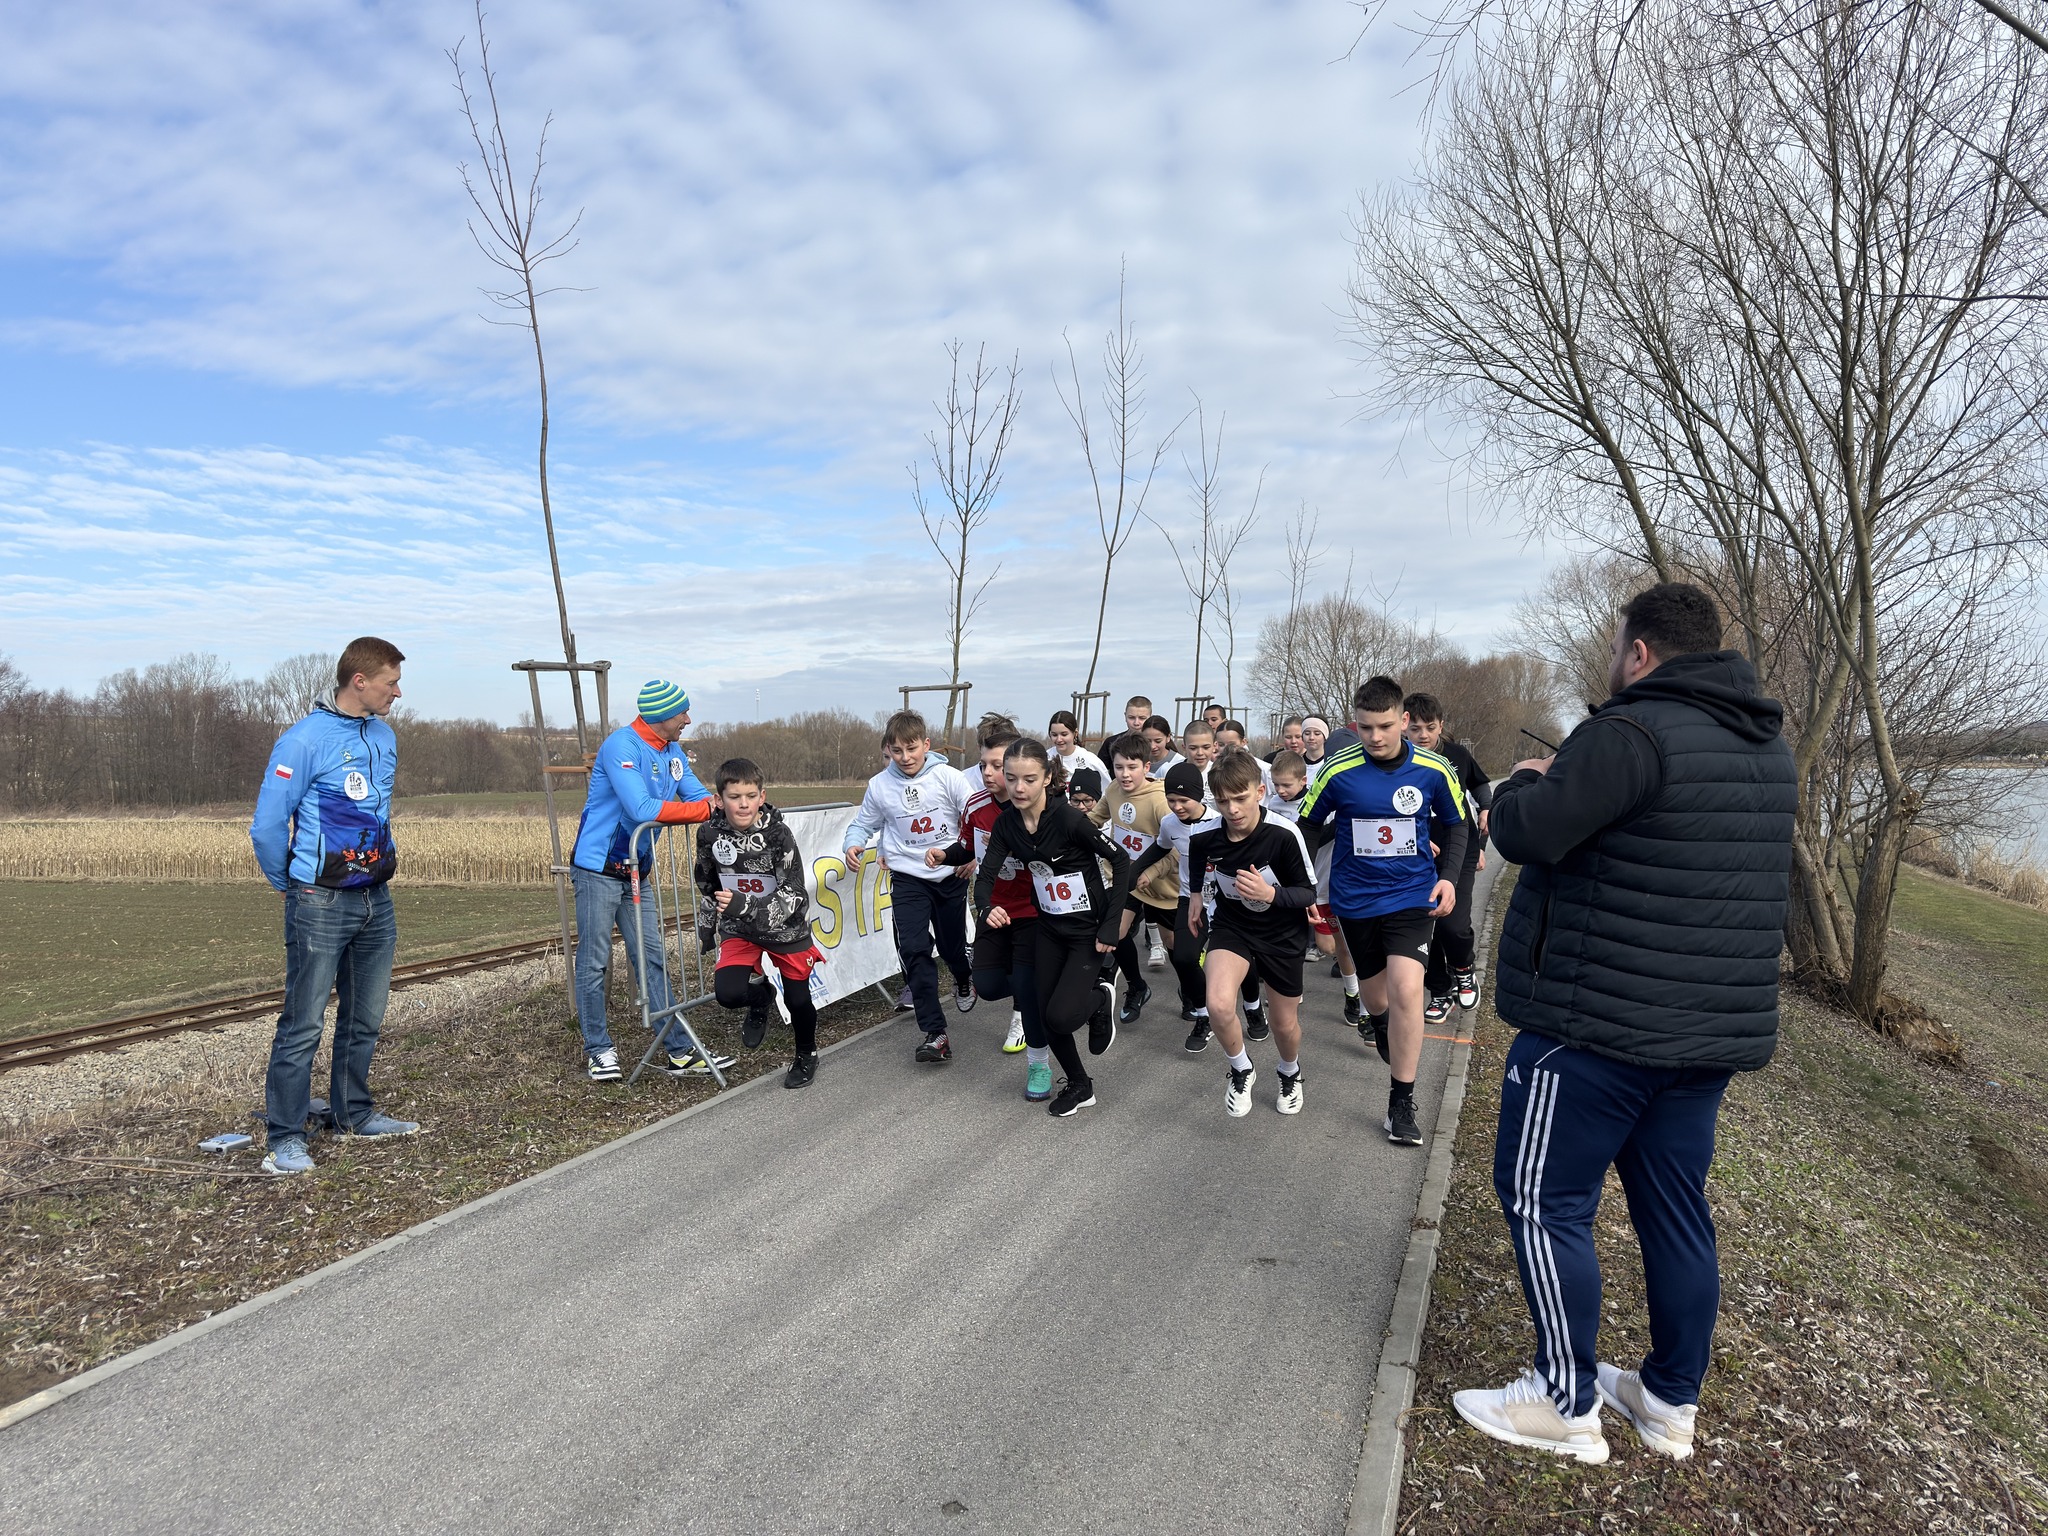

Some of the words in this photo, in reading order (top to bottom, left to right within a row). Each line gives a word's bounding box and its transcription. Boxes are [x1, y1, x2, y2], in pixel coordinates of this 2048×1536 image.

[910, 816, 935, 834] 42
[1122, 834, 1142, 851] 45
[1377, 825, 1393, 844] 3
[737, 878, 764, 893] 58
[1044, 882, 1071, 901] 16
